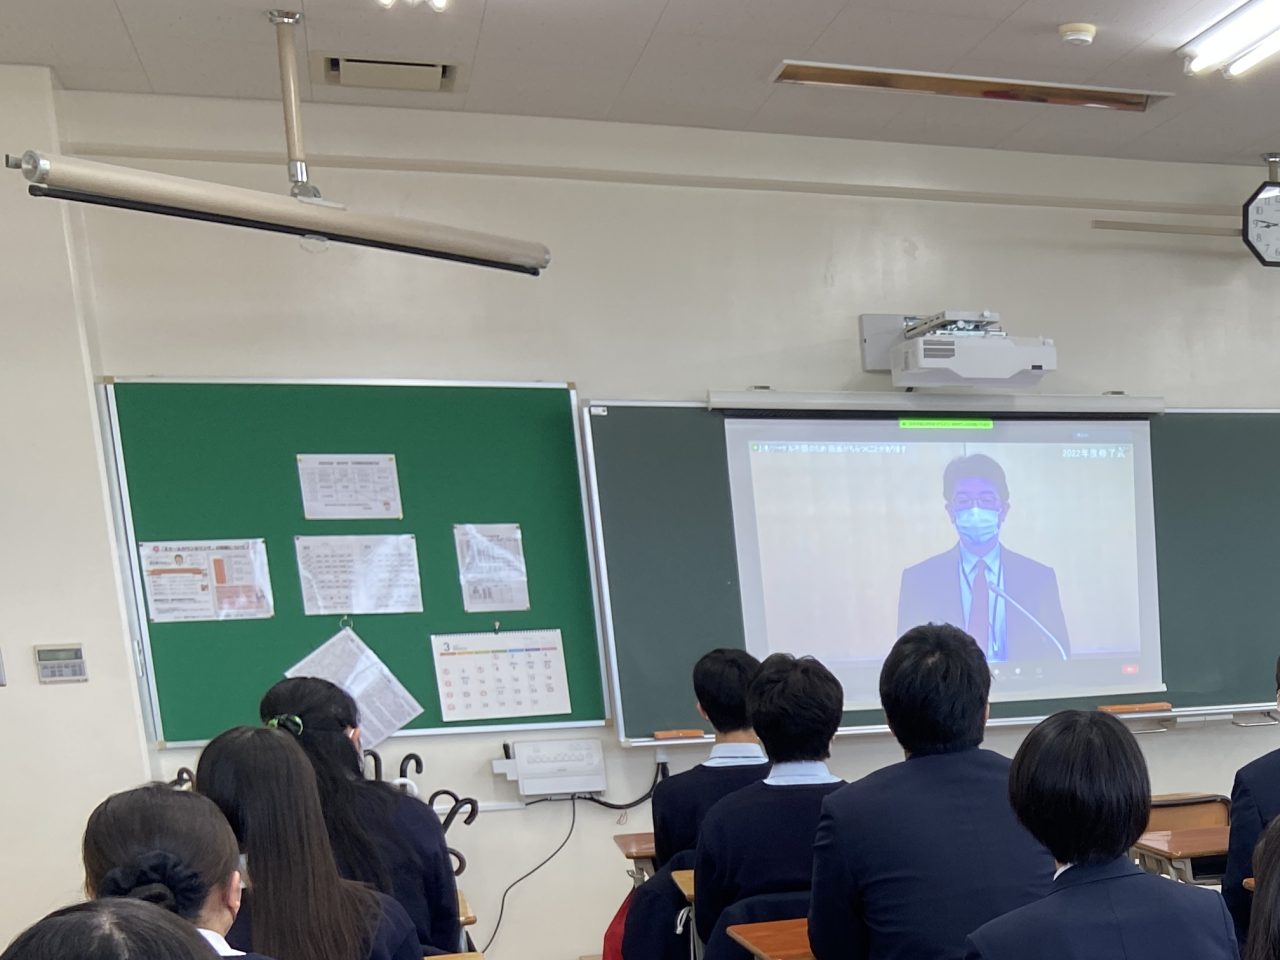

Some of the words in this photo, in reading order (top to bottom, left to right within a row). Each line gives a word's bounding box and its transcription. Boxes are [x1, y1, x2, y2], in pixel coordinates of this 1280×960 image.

[1255, 206, 1263, 215] 10
[1274, 247, 1280, 256] 6
[443, 642, 450, 652] 3
